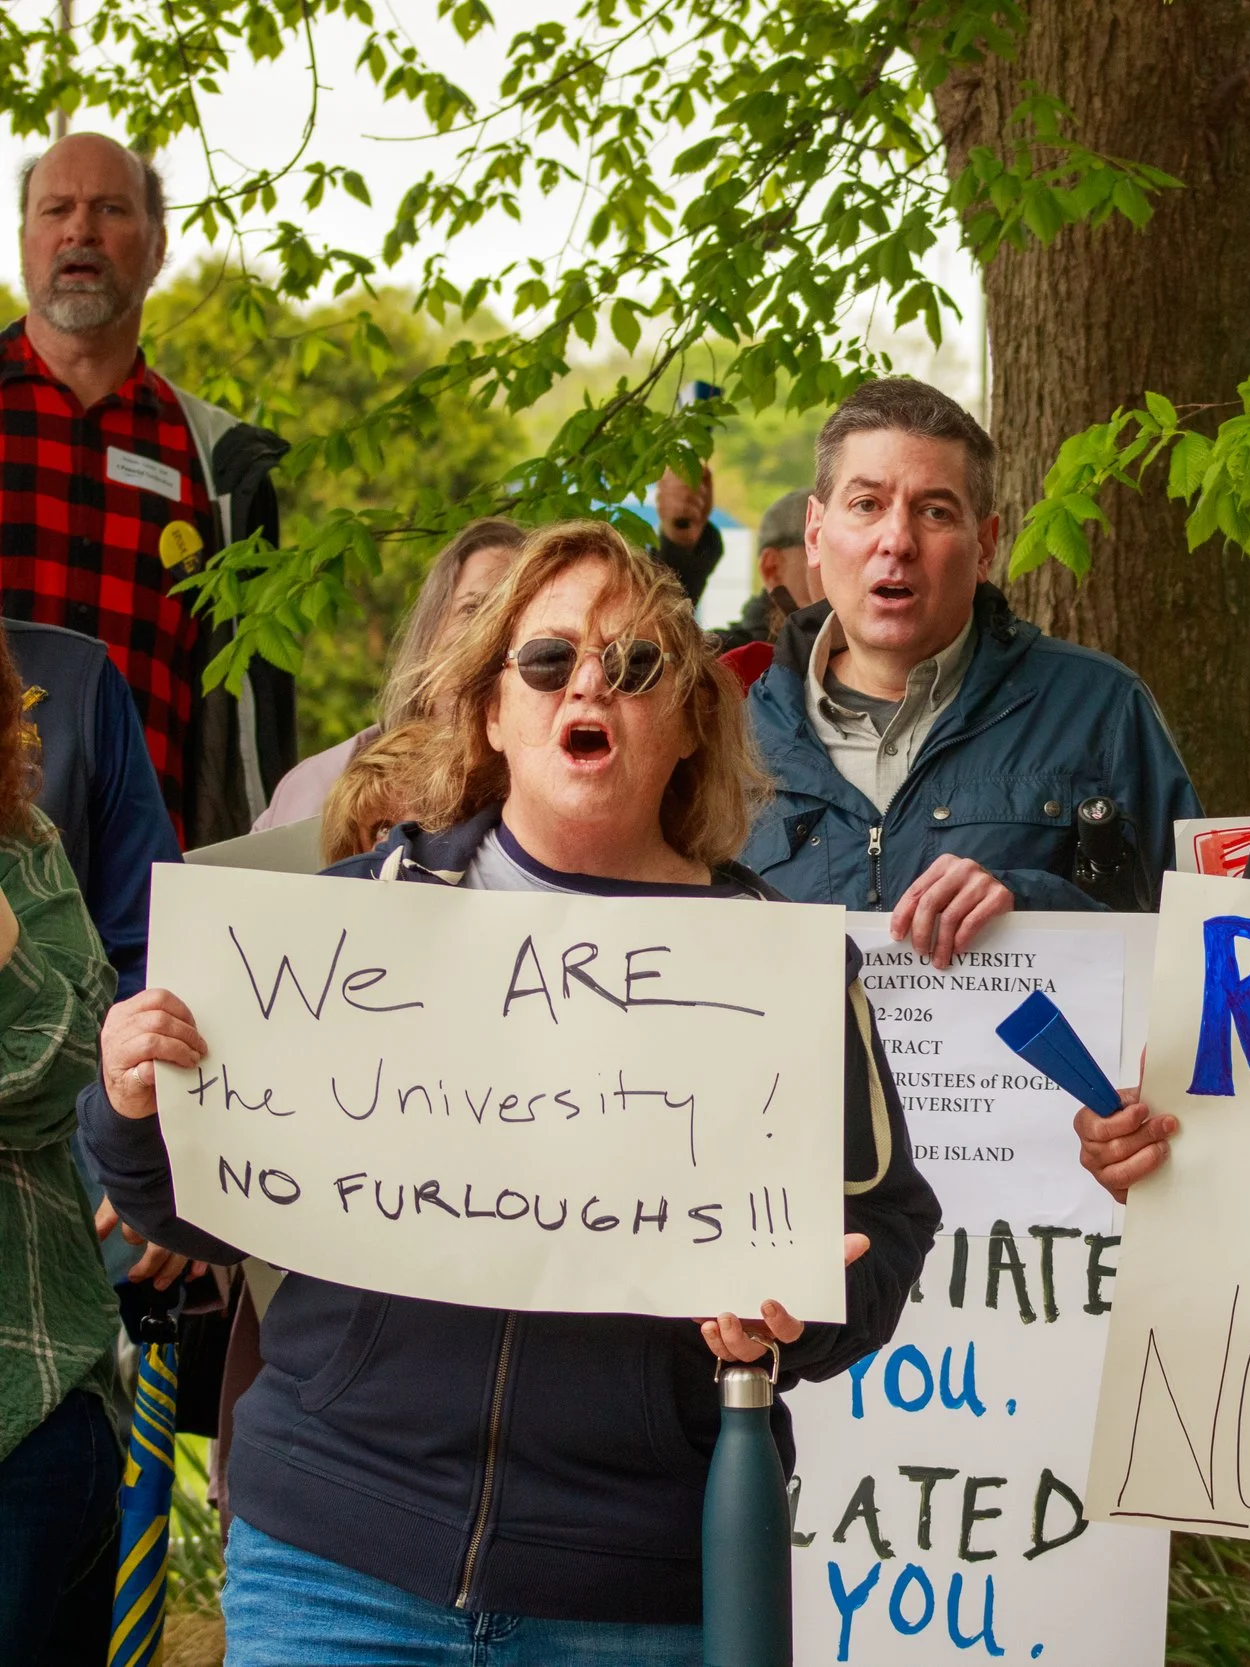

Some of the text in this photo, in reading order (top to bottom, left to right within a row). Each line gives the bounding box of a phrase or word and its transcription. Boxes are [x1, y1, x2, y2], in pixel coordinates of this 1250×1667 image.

[864, 951, 1037, 968] IAMS UIVERSITY
[227, 925, 765, 1024] We ARE
[863, 975, 1057, 993] CIATION NEARI/NEA
[876, 1007, 933, 1023] 2-2026
[881, 1039, 944, 1055] TRACT
[891, 1072, 1062, 1091] RUSTEES of ROGE
[187, 1064, 296, 1118] the
[331, 1057, 698, 1167] University
[944, 1146, 1015, 1162] ISLAND
[218, 1155, 302, 1205] NO
